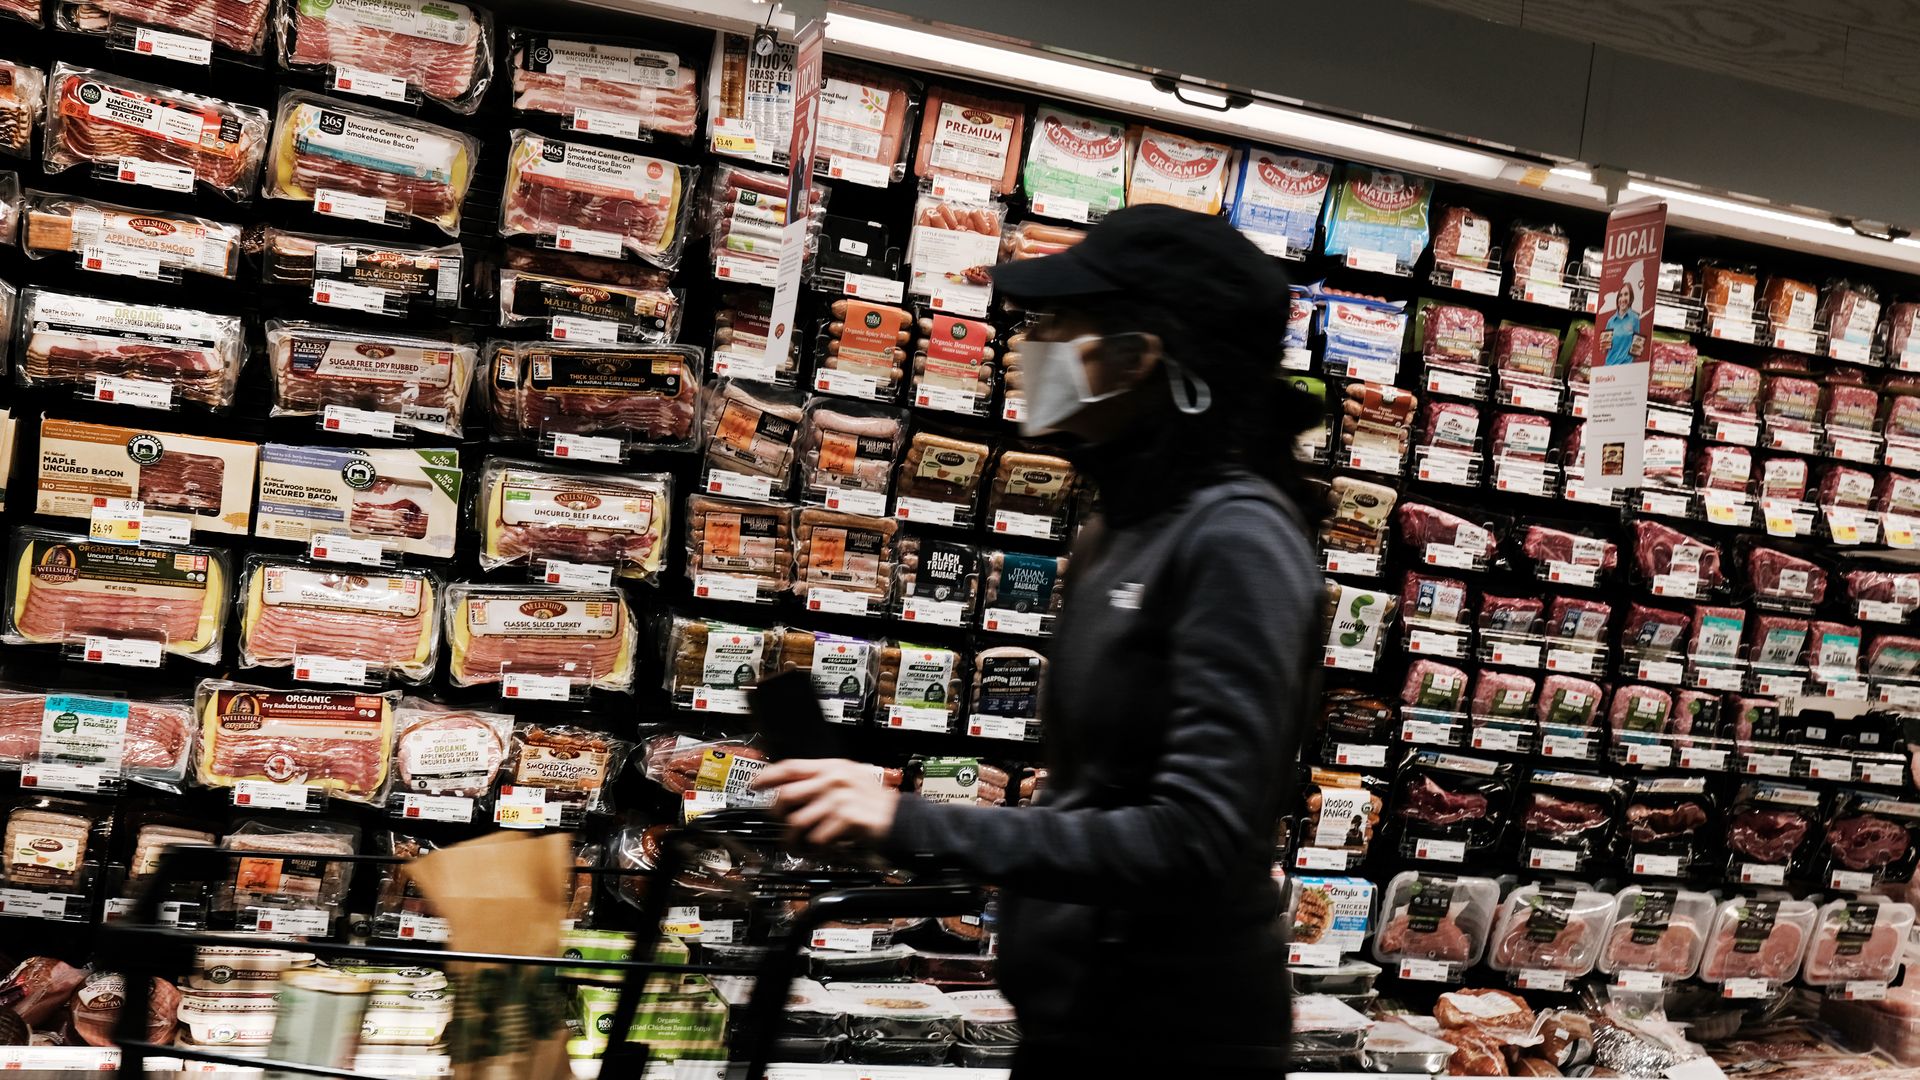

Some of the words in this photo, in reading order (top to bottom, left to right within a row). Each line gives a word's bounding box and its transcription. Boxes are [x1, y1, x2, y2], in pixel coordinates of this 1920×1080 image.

[382, 5, 415, 19] BACON
[555, 50, 598, 59] STEAKHOUSE
[600, 53, 629, 63] SMOKED
[566, 56, 592, 64] UNCURED
[757, 54, 792, 71] 100%
[750, 70, 792, 81] GRASS-FED
[796, 61, 818, 100] LOCAL
[749, 80, 774, 93] BEEF
[108, 98, 152, 114] UNCURED
[112, 111, 144, 123] BACON
[322, 114, 343, 128] 365
[348, 121, 378, 134] Uncured
[379, 128, 404, 141] Center
[406, 135, 419, 143] Cut
[946, 120, 1002, 142] PREMIUM
[346, 130, 391, 146] Smokehouse
[393, 140, 415, 150] Bacon
[716, 138, 732, 147] $3.49
[1053, 128, 1116, 156] ORGANIC
[545, 143, 563, 156] 365
[568, 145, 597, 157] Uncured
[598, 150, 621, 161] Center
[622, 155, 635, 163] Cut
[567, 152, 609, 166] Smokehouse
[611, 160, 631, 170] Bacon
[1149, 153, 1207, 175] ORGANIC
[567, 159, 596, 170] Reduced
[598, 165, 622, 176] Sodium
[131, 220, 174, 232] WELLSHIRE
[106, 233, 158, 247] APPLEWOOD
[161, 242, 195, 254] SMOKED
[1607, 227, 1657, 260] LOCAL
[355, 269, 385, 278] BLACK
[544, 297, 578, 309] MAPLE
[581, 304, 627, 318] BOURBON
[61, 310, 84, 318] COUNTRY
[115, 308, 164, 321] ORGANIC
[124, 318, 143, 327] SMOKED
[144, 321, 165, 329] UNCURED
[166, 323, 181, 331] BACON
[845, 327, 864, 336] Organic
[866, 330, 879, 339] Spicy
[879, 332, 896, 340] Italian
[294, 342, 327, 351] PALEO
[932, 338, 954, 347] Organic
[954, 342, 981, 352] Bratwurst
[329, 358, 355, 366] SUGAR
[375, 361, 390, 369] DRY
[391, 362, 419, 371] RUBBED
[43, 456, 76, 465] MAPLE
[439, 455, 450, 465] NO
[43, 464, 88, 474] UNCURED
[92, 468, 123, 477] BACON
[434, 473, 453, 493] SUGAR
[443, 473, 453, 483] NO
[264, 482, 303, 490] APPLEWOOD
[263, 488, 305, 498] UNCURED
[308, 493, 337, 502] BACON
[556, 493, 600, 504] WELLSHIRE
[534, 509, 571, 518] UNCURED
[573, 512, 590, 520] BEEF
[592, 514, 620, 522] BACON
[92, 524, 113, 534] $6.99
[79, 545, 116, 554] ORGANIC
[932, 551, 960, 563] BLACK
[37, 565, 79, 576] WELLSHIRE
[926, 560, 964, 574] TRUFFLE
[1013, 568, 1045, 577] ITALIAN
[931, 569, 957, 580] SAUSAGE
[1008, 574, 1049, 585] WEDDING
[1014, 582, 1039, 591] SAUSAGE
[521, 602, 563, 612] WELLSHIRE
[286, 695, 331, 704] ORGANIC
[225, 722, 259, 730] organic
[434, 744, 467, 752] ORGANIC
[526, 763, 560, 772] SMOKED
[734, 758, 765, 770] TETON
[735, 769, 760, 783] 100%
[726, 786, 740, 794] BEEF
[1324, 798, 1353, 809] VOODOO
[502, 810, 519, 820] $5.49
[1323, 808, 1352, 819] RANGER
[657, 1017, 681, 1025] Organic
